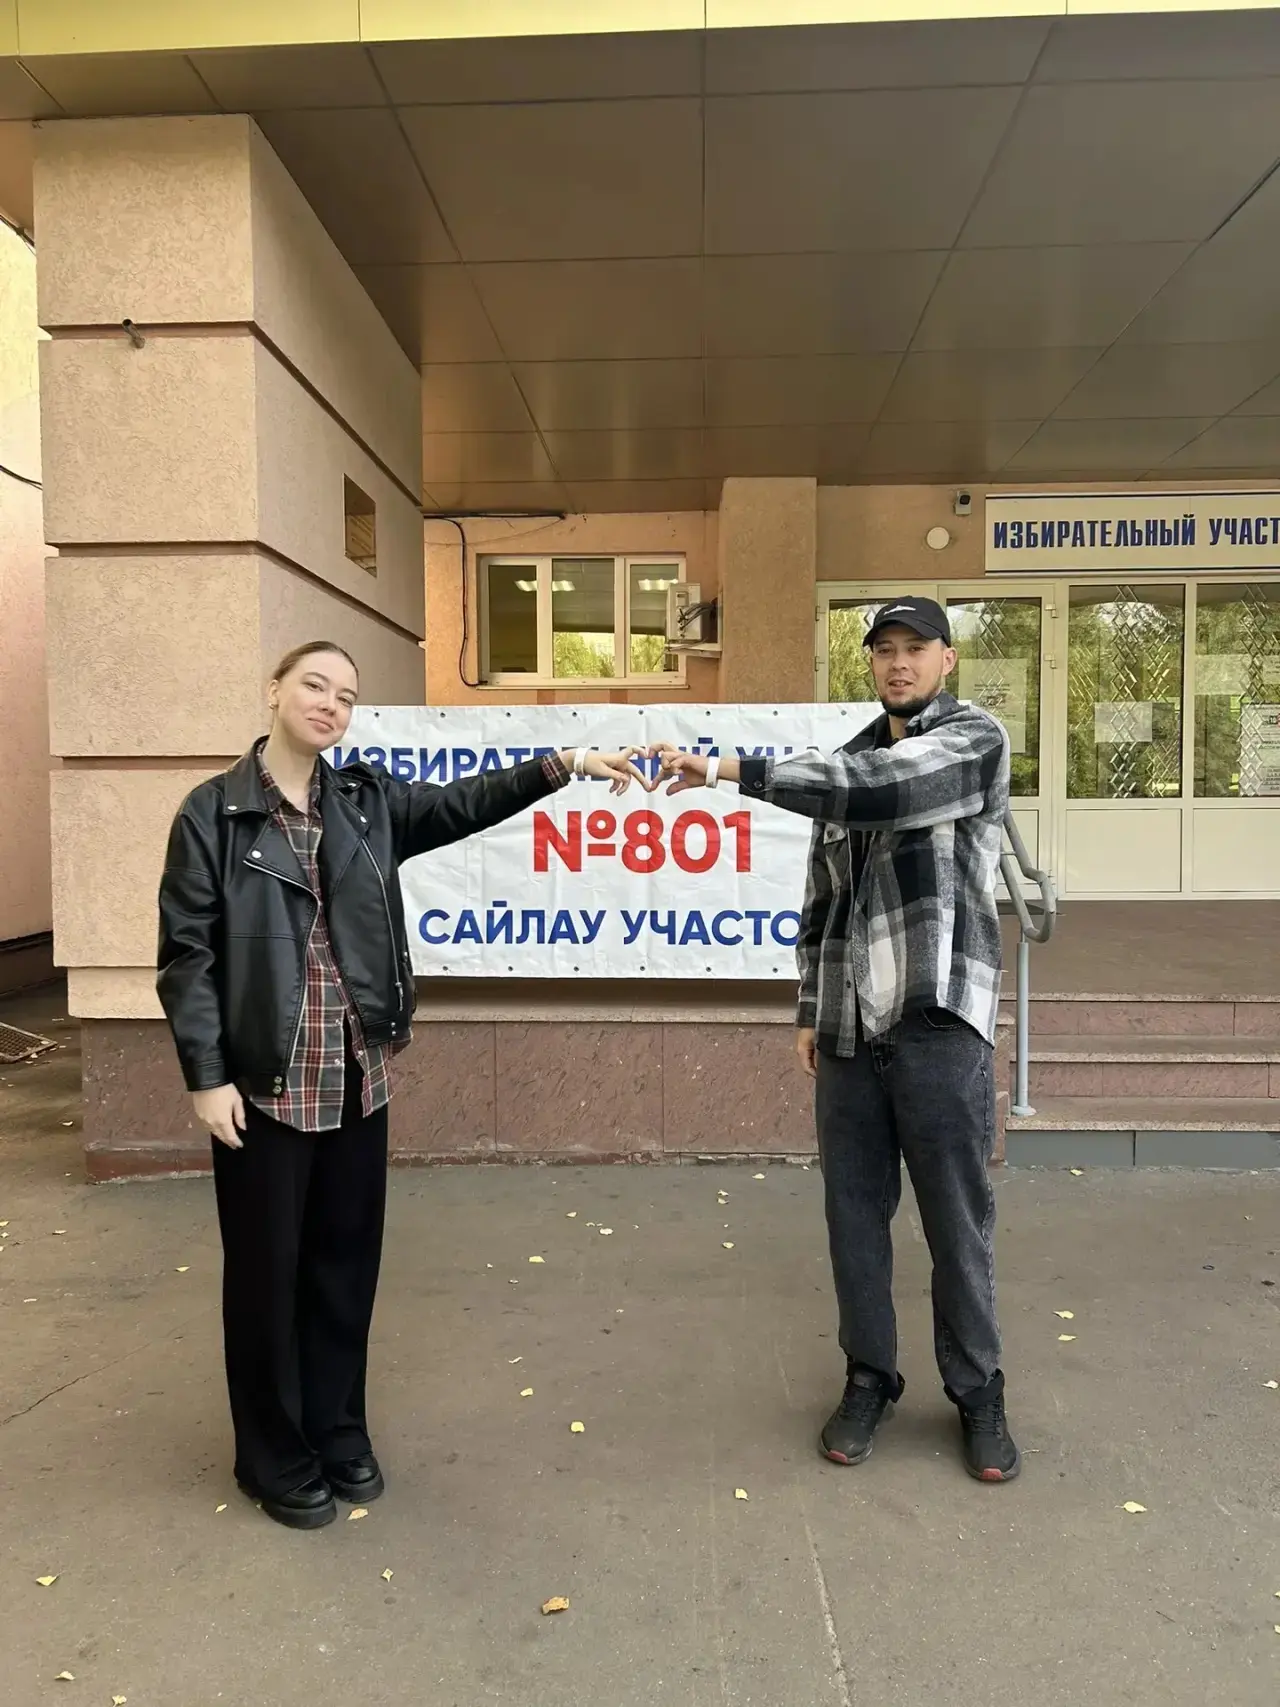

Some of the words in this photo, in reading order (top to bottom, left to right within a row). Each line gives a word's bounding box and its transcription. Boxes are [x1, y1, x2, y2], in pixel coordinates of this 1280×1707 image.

[993, 513, 1196, 549] ИЗБИРАТЕЛЬНЫЙ
[533, 810, 752, 873] №801
[418, 900, 607, 946] САЙЛАУ
